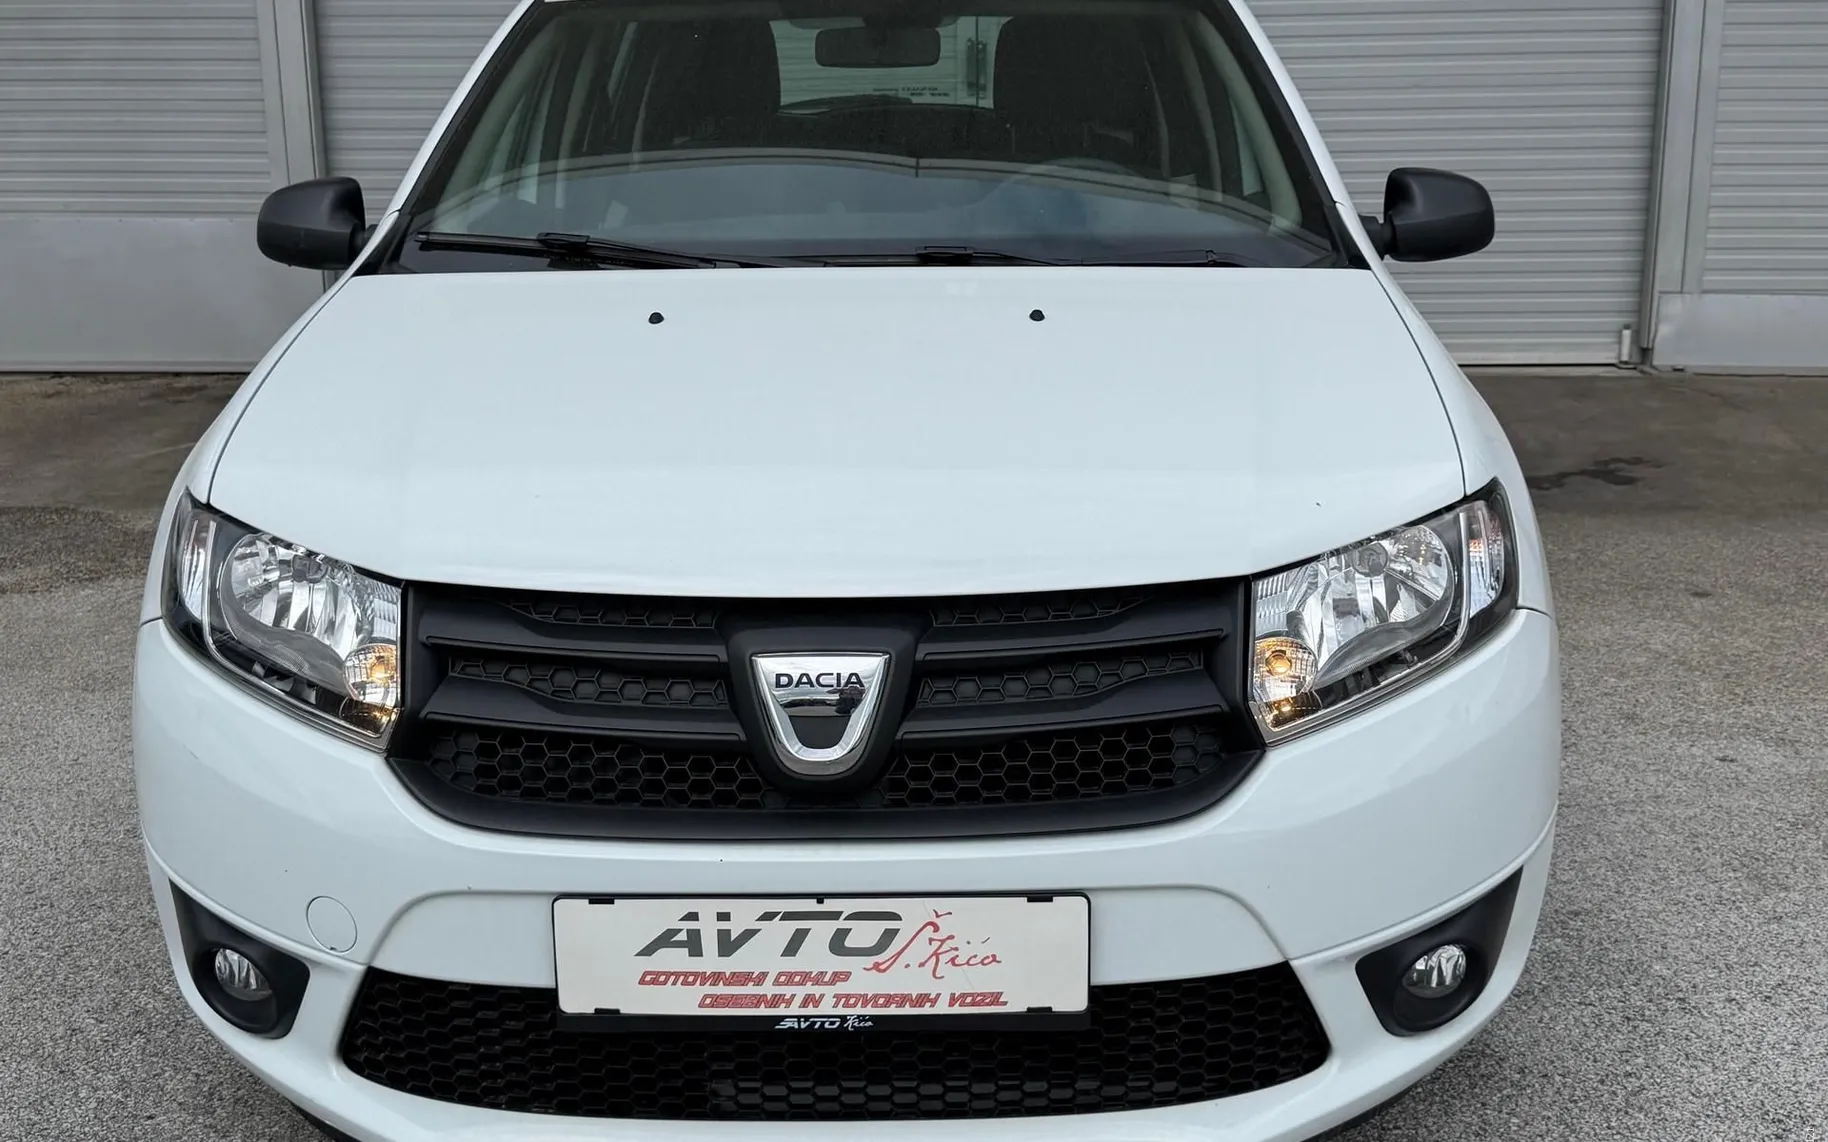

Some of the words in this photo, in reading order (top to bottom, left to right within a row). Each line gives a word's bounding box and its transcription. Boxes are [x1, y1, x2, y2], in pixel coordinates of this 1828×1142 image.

[775, 673, 865, 688] DACIA
[633, 911, 903, 958] AVTO
[638, 970, 770, 987] GOTOVINSKI
[772, 970, 852, 987] ODKUP
[698, 993, 797, 1009] OSEBNIH
[798, 993, 825, 1009] IN
[832, 993, 943, 1009] TOVORNIH
[948, 991, 1009, 1008] VOZIL
